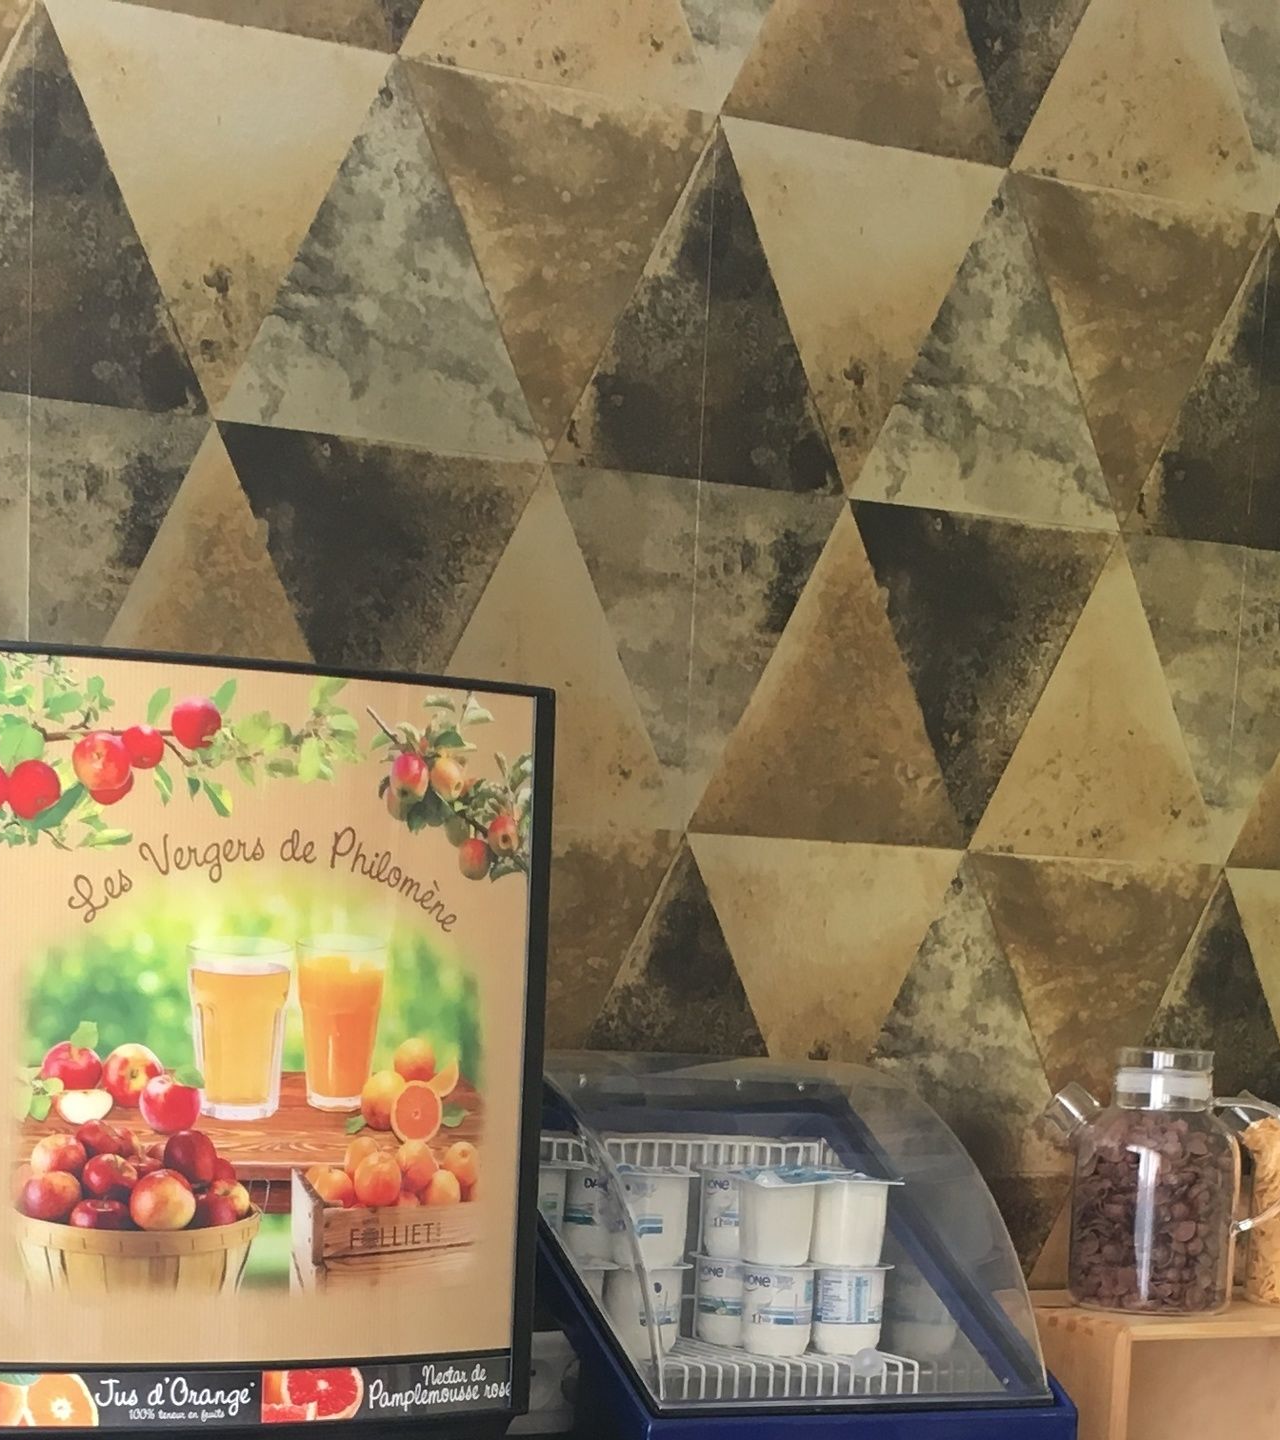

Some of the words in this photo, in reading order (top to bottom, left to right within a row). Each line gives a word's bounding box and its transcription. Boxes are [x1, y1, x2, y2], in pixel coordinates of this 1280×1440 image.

[67, 866, 133, 924] Les
[139, 831, 266, 884] Vergers
[279, 828, 318, 864] de
[330, 826, 458, 933] Philomène
[422, 1364, 468, 1386] Nectar
[471, 1362, 487, 1382] de
[95, 1378, 138, 1408] Jus
[368, 1378, 481, 1413] Pamplemousse
[128, 1407, 155, 1421] 100%
[187, 1410, 199, 1420] en
